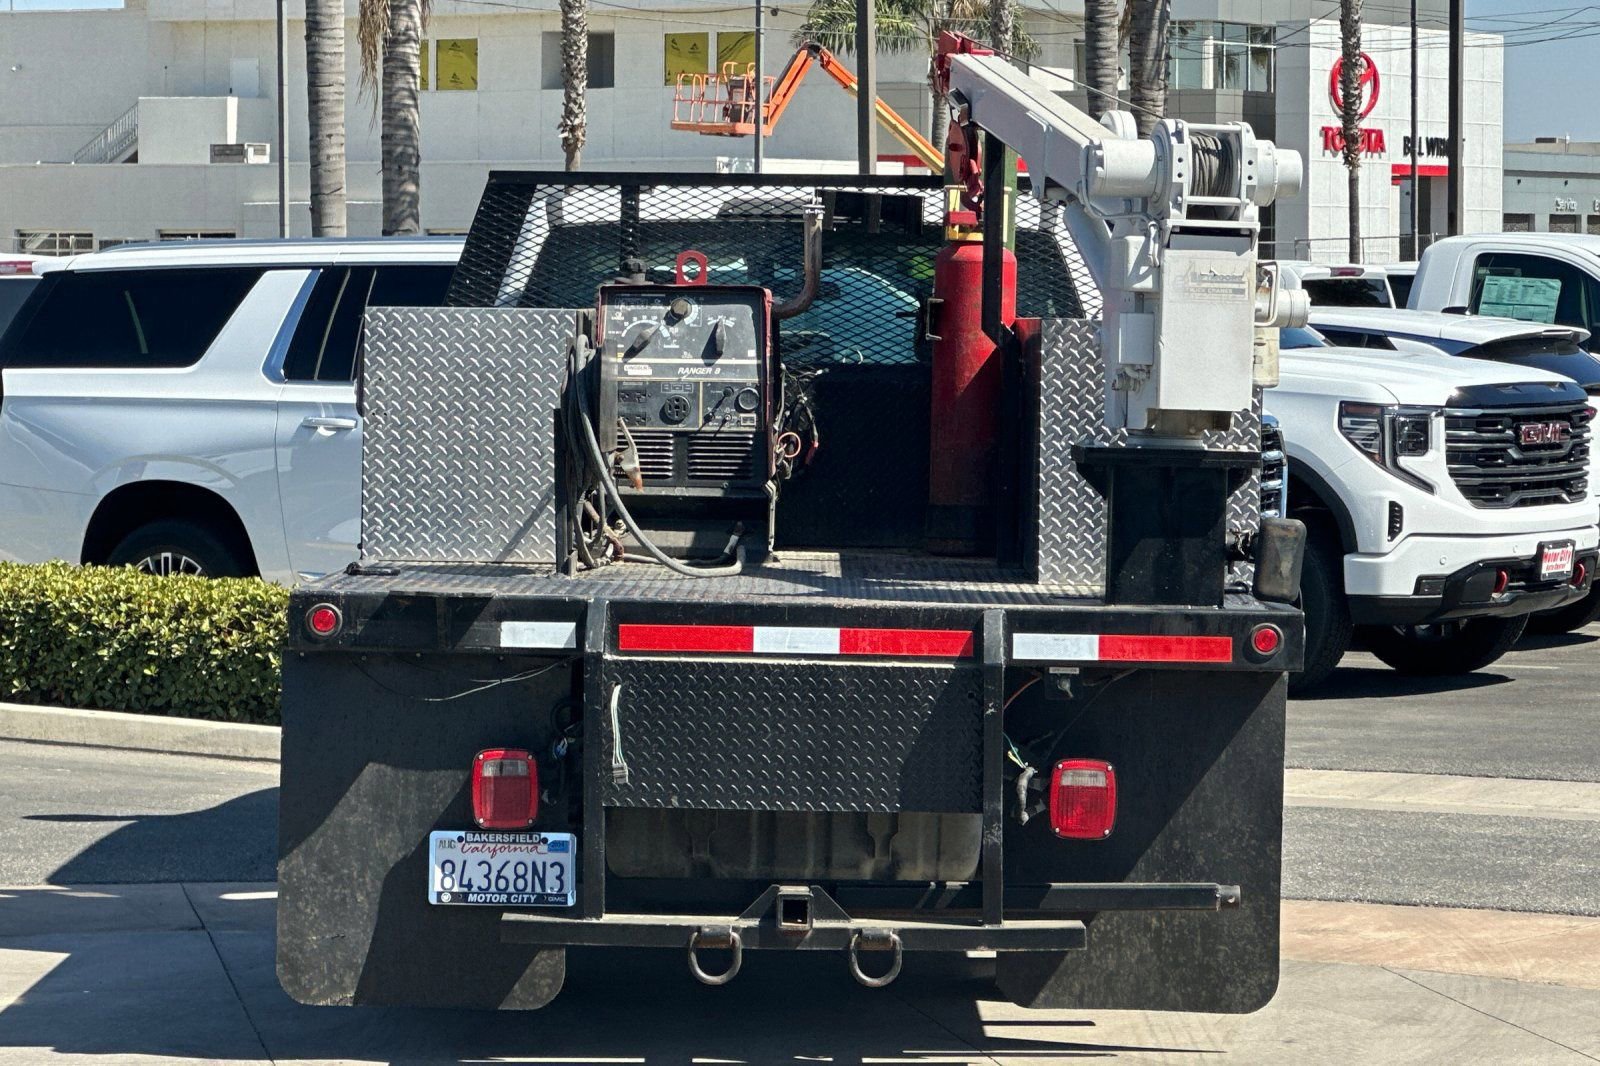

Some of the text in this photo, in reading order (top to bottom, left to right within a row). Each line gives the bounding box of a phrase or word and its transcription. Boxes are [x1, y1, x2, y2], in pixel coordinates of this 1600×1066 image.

[1321, 126, 1386, 153] TOOTA
[677, 367, 712, 375] RANGER
[1521, 422, 1571, 445] GMC
[466, 833, 540, 843] BAKERSFIELD
[461, 844, 548, 859] California
[440, 859, 565, 894] 84368N3
[467, 893, 538, 903] MOTOR CITY
